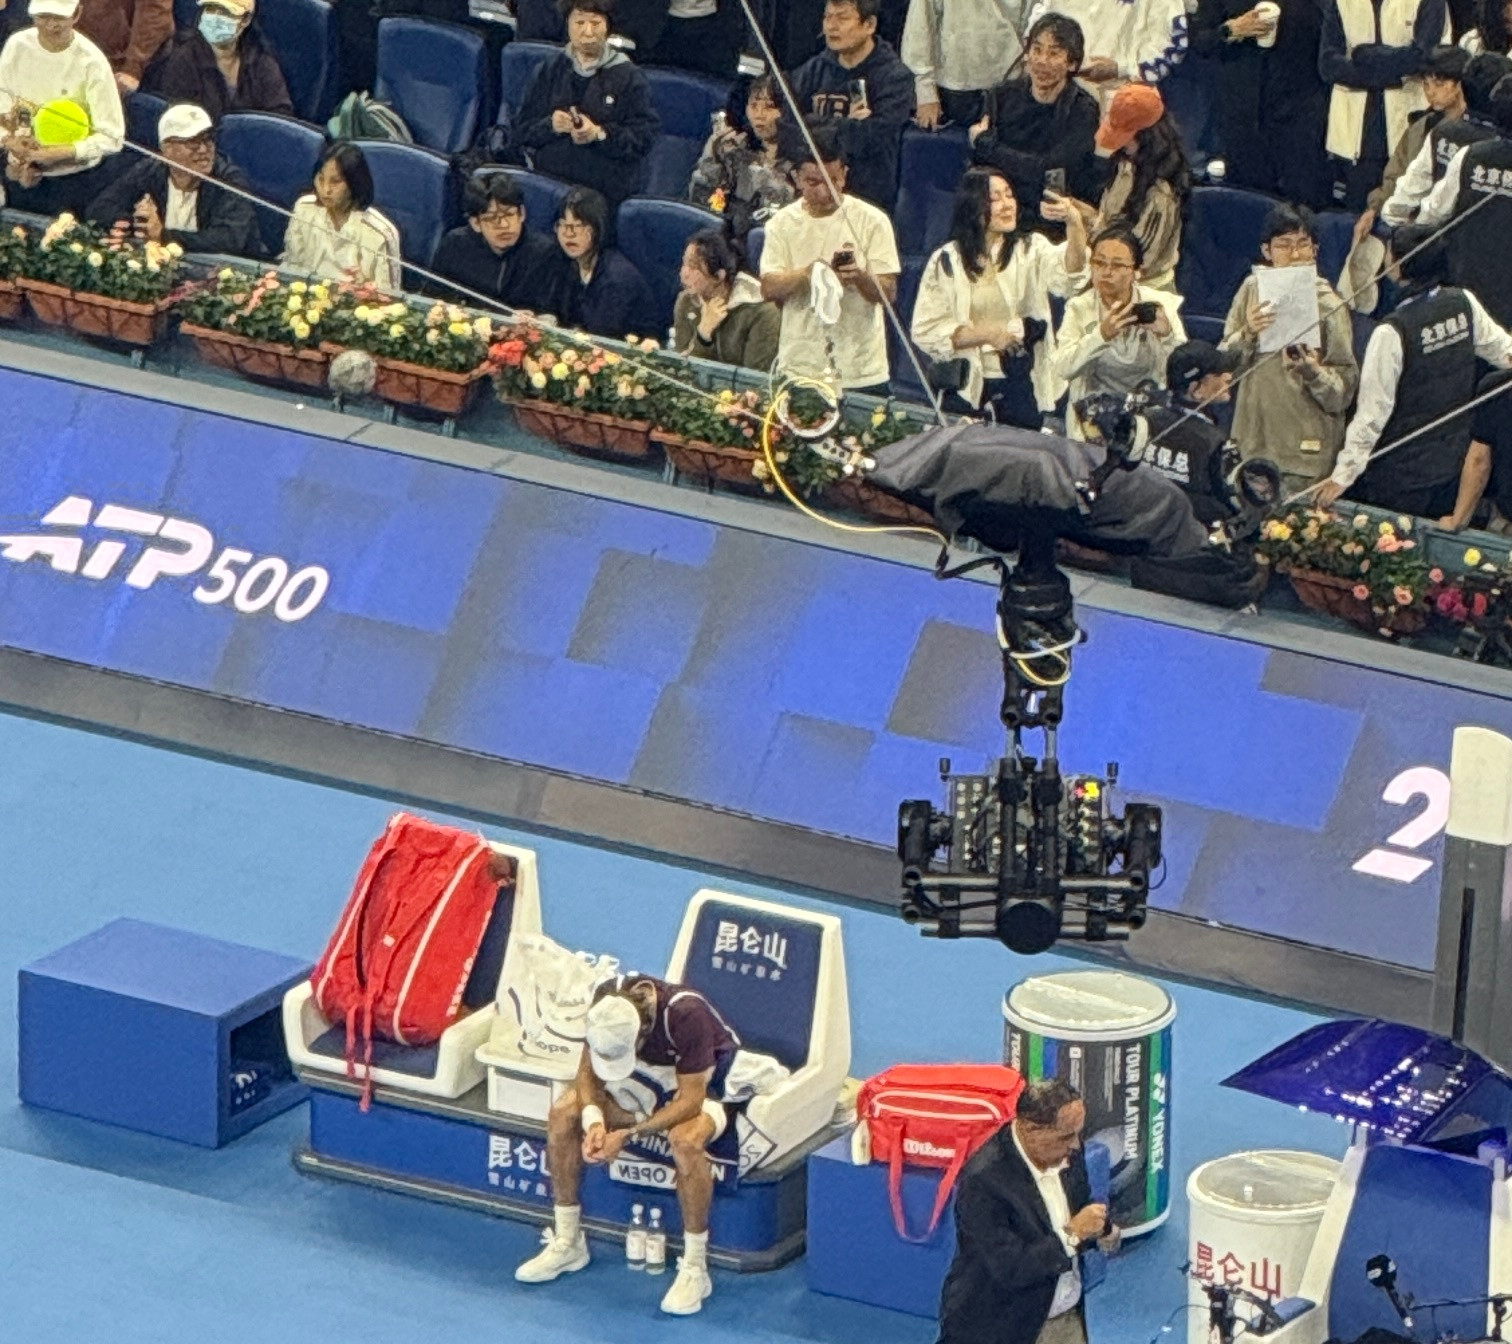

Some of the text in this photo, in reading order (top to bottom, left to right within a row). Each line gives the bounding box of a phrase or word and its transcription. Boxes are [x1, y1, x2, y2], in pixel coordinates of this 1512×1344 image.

[0, 495, 329, 623] ATP 500
[713, 920, 788, 971] 昆仑山
[1124, 1042, 1142, 1161] TOUR PLATINUM
[1151, 1109, 1165, 1175] YONEX
[1193, 1241, 1281, 1298] 昆仑山
